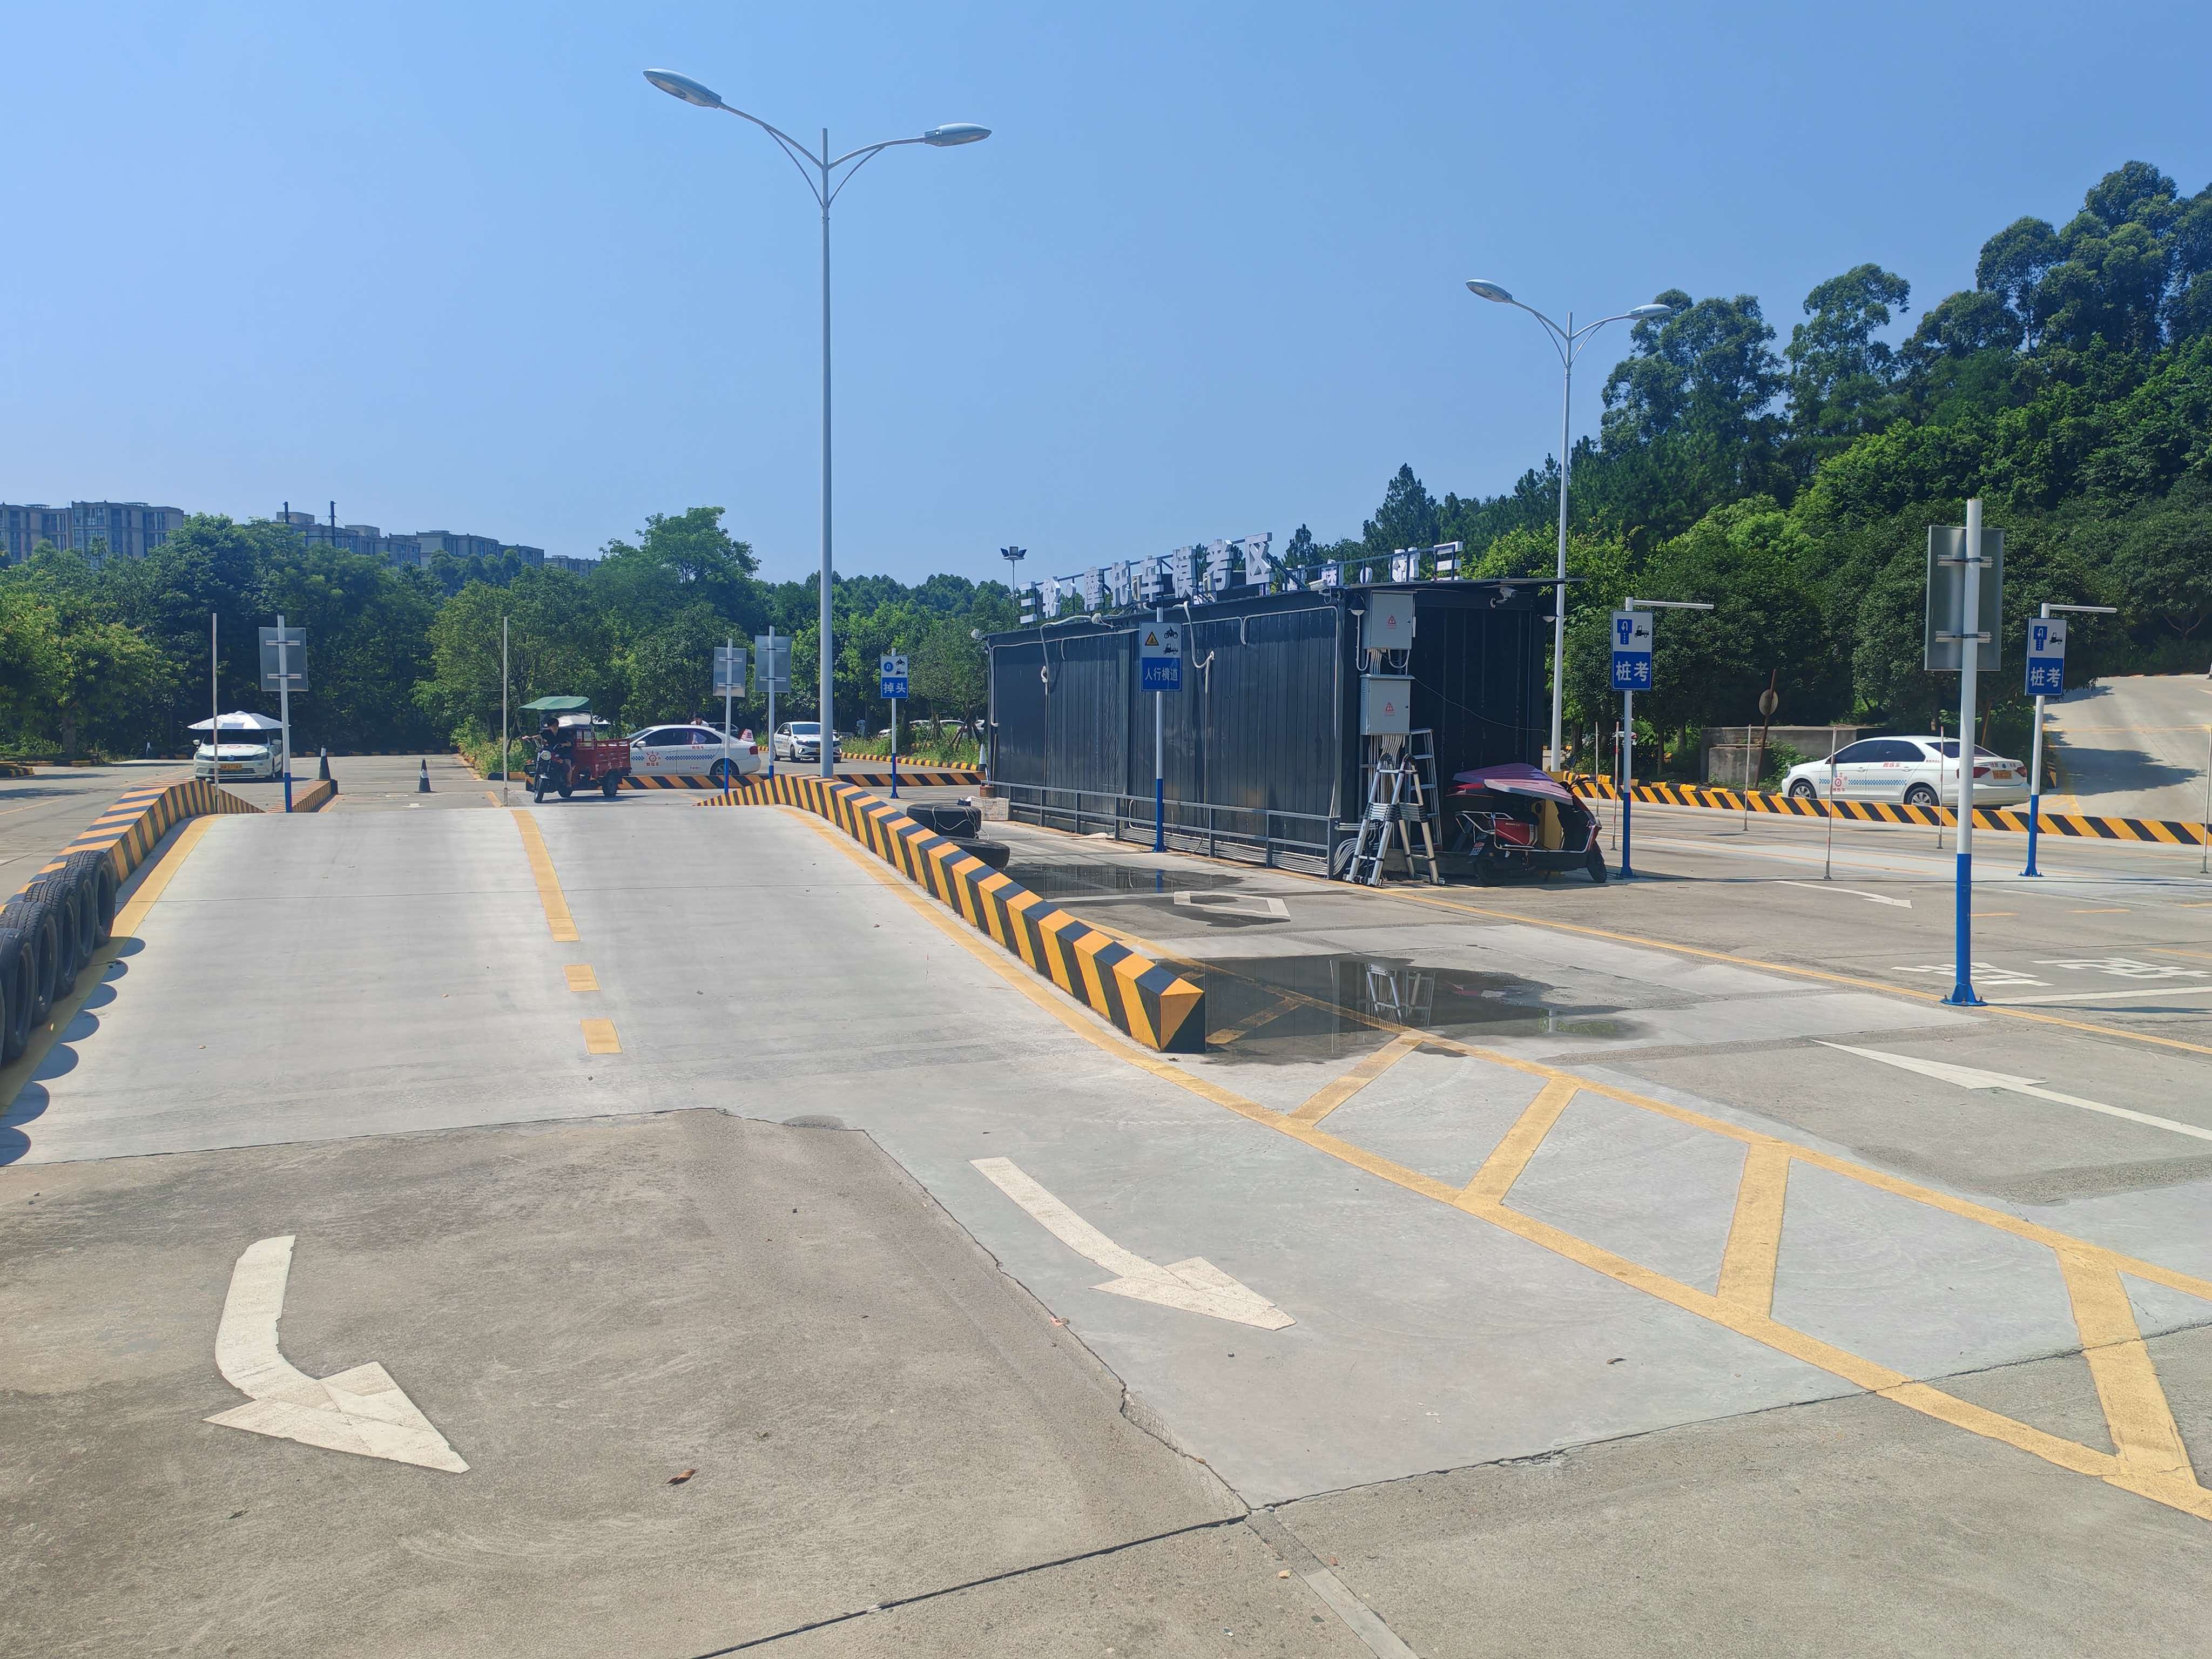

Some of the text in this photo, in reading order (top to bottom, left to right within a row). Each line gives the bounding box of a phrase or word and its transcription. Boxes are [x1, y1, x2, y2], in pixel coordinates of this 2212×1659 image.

[1145, 667, 1178, 682] 人行横道
[1616, 661, 1649, 682] 桩考
[2030, 667, 2061, 687] 桩考
[883, 682, 906, 693] 掉头
